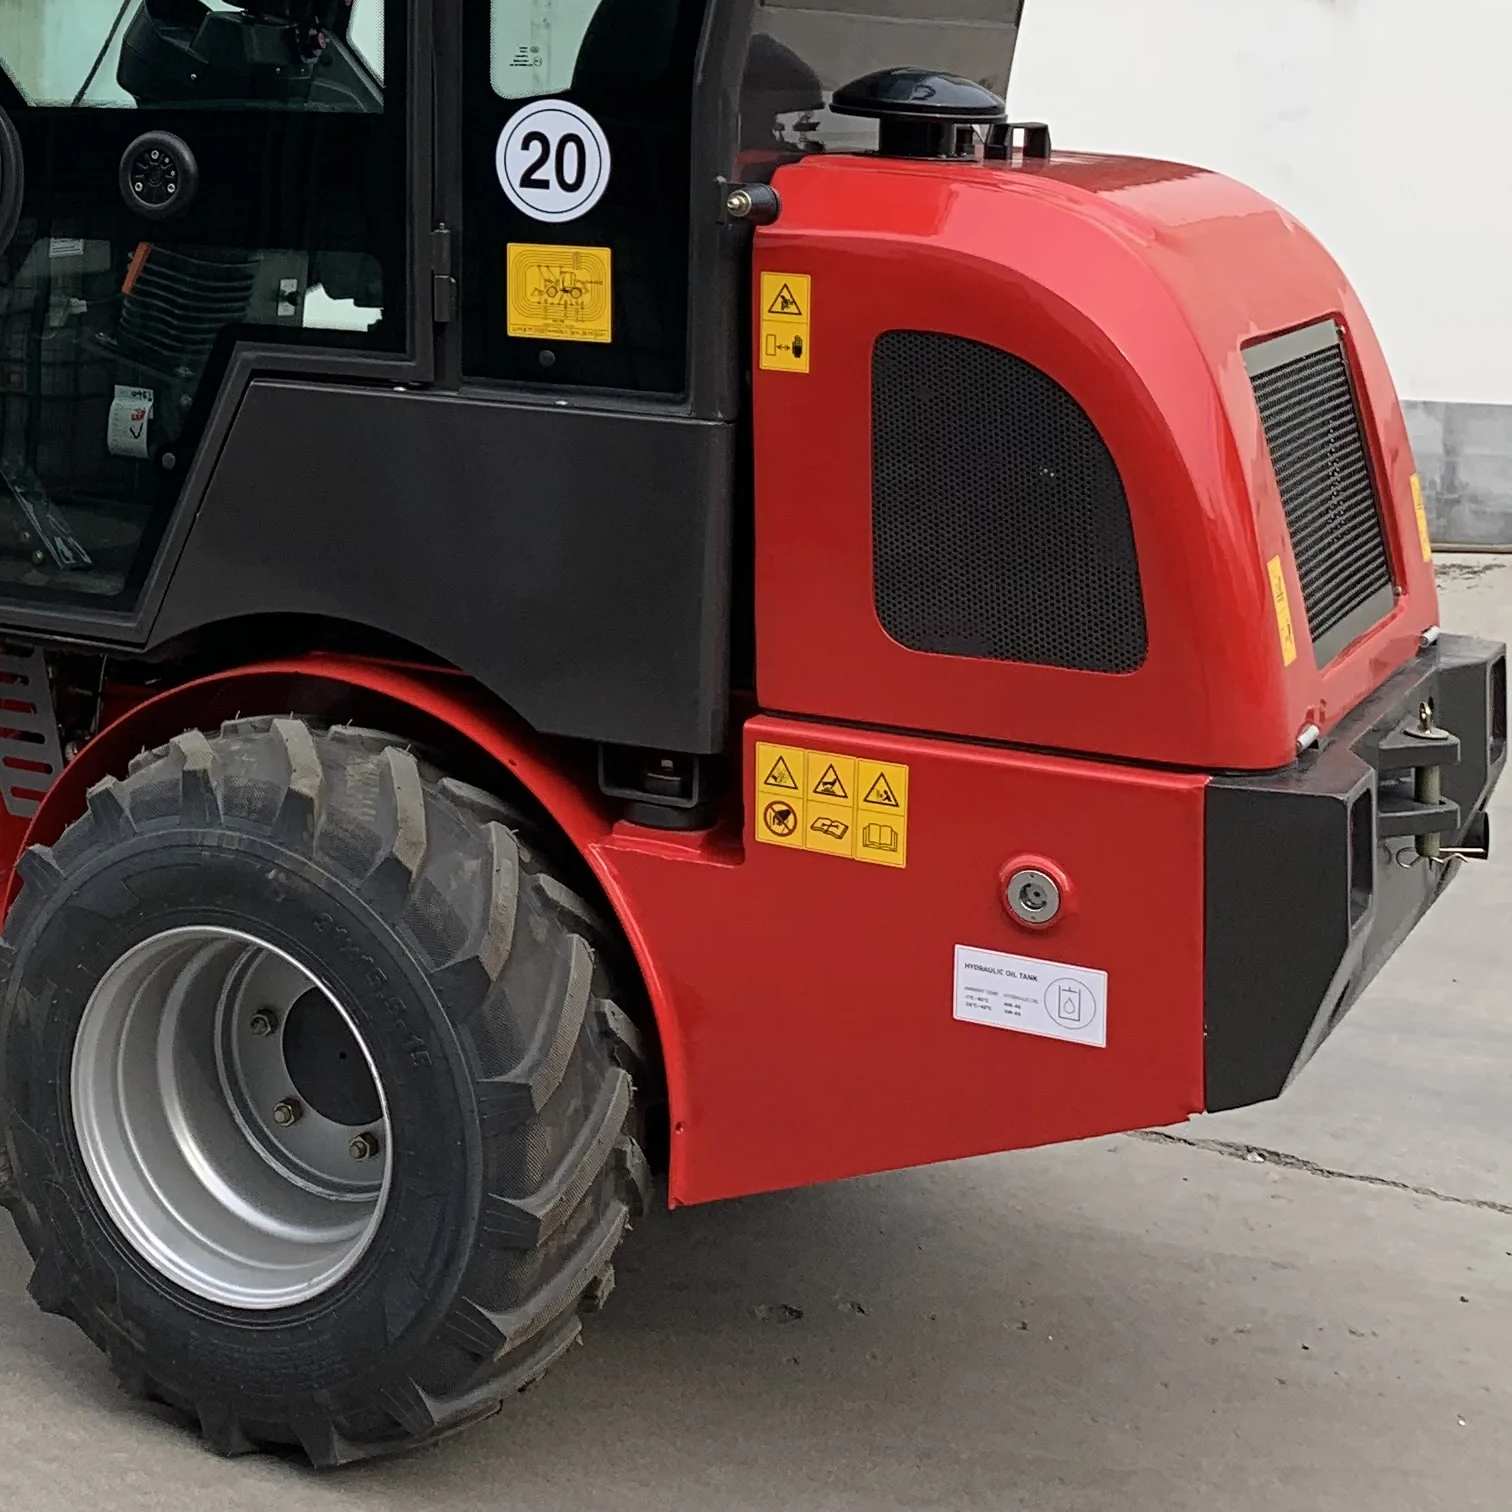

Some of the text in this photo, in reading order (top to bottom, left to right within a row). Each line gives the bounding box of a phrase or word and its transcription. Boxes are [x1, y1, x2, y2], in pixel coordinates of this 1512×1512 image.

[519, 131, 586, 193] 20
[964, 962, 1038, 982] HYDRAULIC OIL TANK
